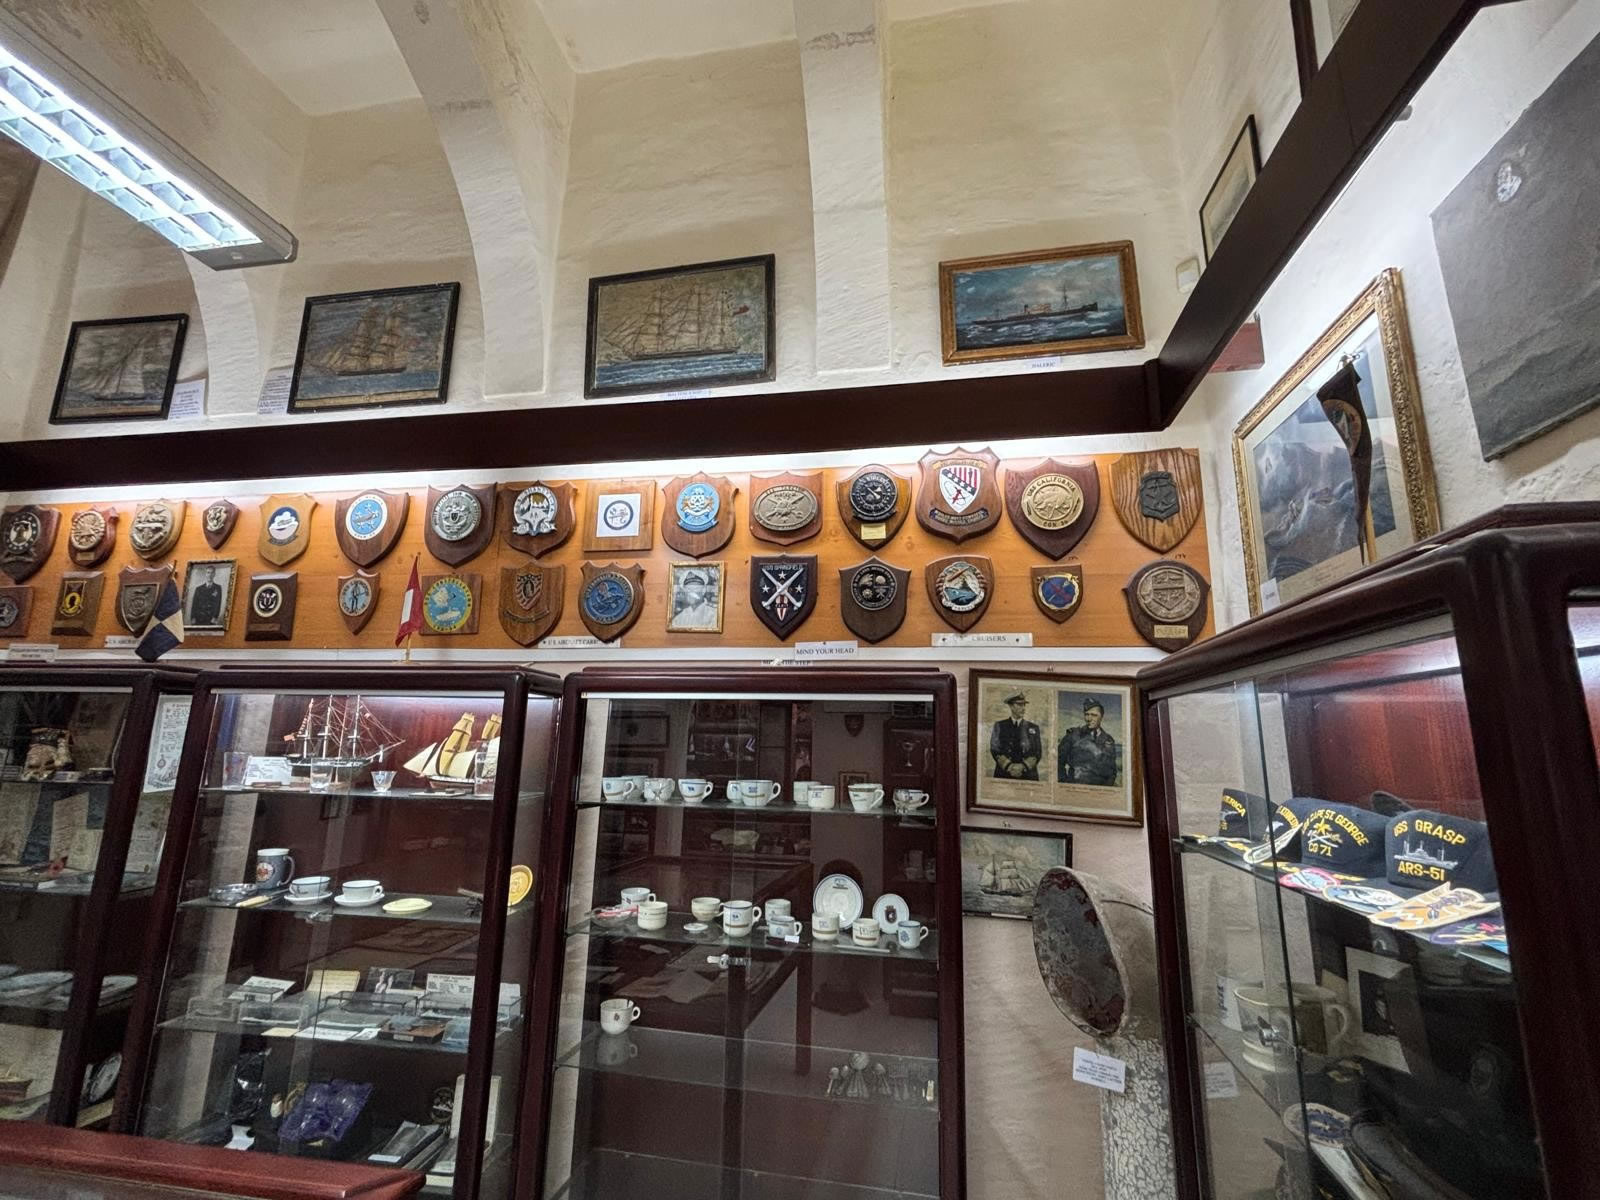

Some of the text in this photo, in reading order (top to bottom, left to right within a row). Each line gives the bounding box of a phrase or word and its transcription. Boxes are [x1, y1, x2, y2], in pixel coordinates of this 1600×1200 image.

[1027, 476, 1077, 497] USS CALIFORNIA
[1334, 814, 1369, 847] GEORGE
[1394, 819, 1466, 845] USS GRASP
[1309, 842, 1332, 857] CG 71
[1398, 860, 1446, 881] ARS-51
